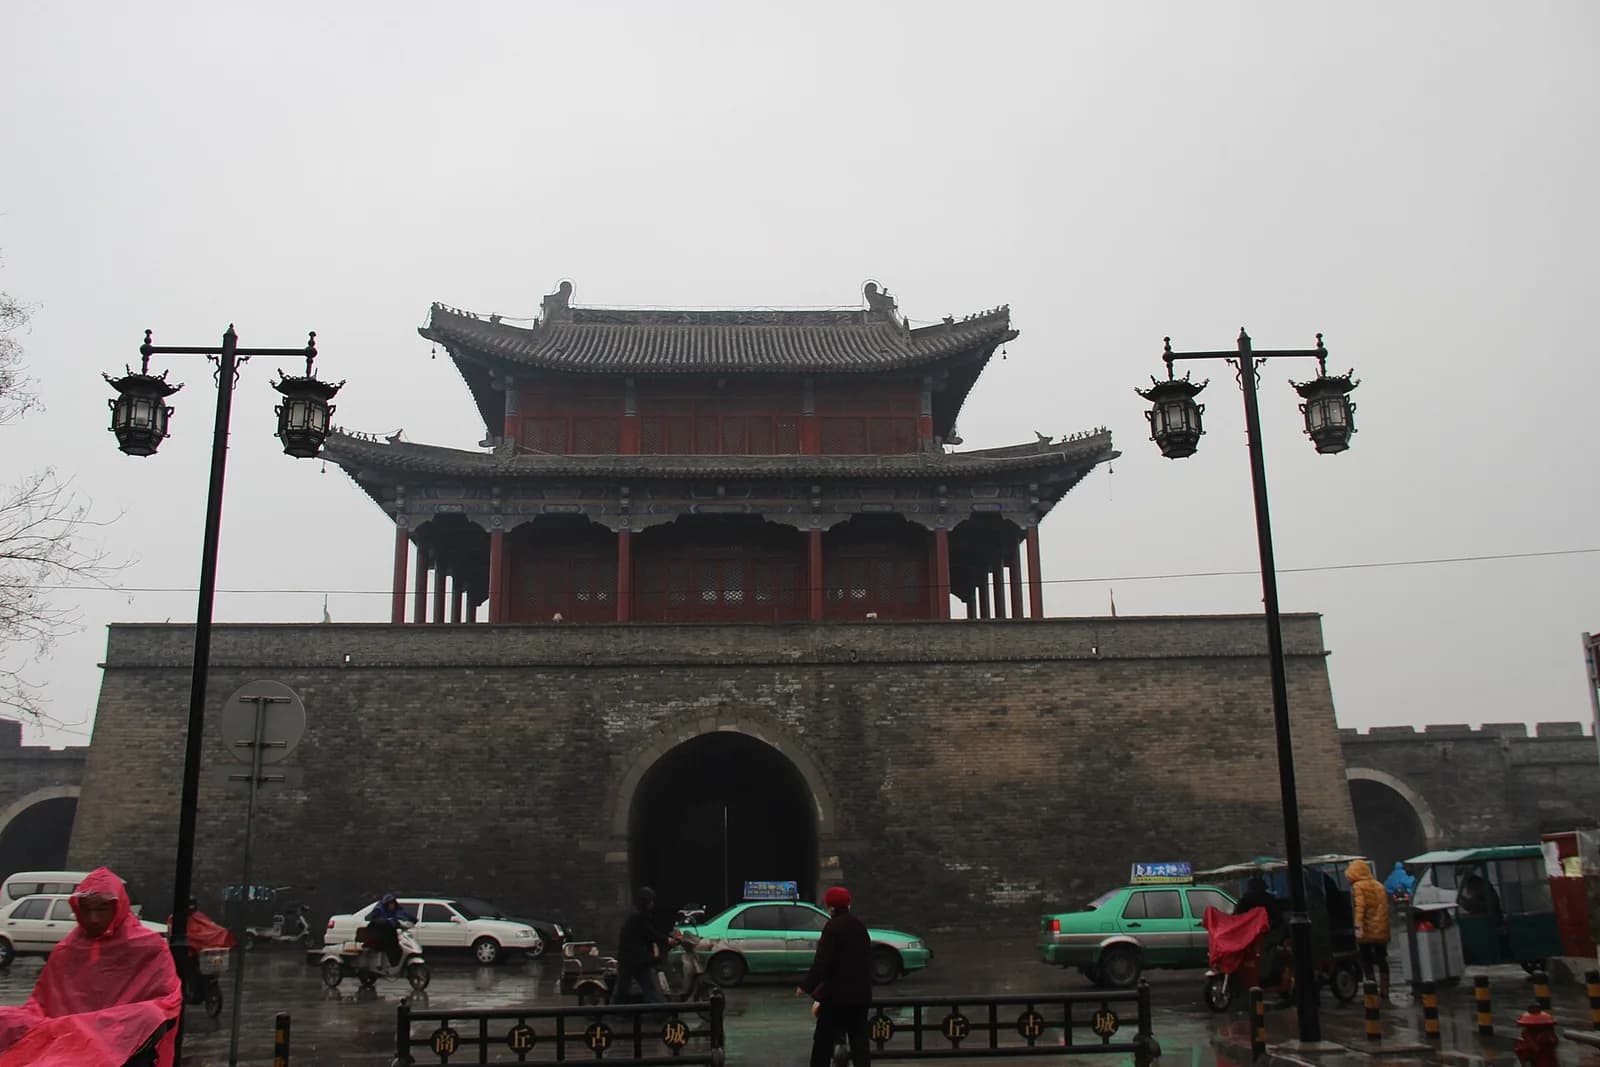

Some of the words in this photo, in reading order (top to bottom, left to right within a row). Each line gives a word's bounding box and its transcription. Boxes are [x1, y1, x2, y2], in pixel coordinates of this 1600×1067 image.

[435, 1023, 687, 1053] 商丘古城
[871, 1013, 1115, 1041] 商丘古城
